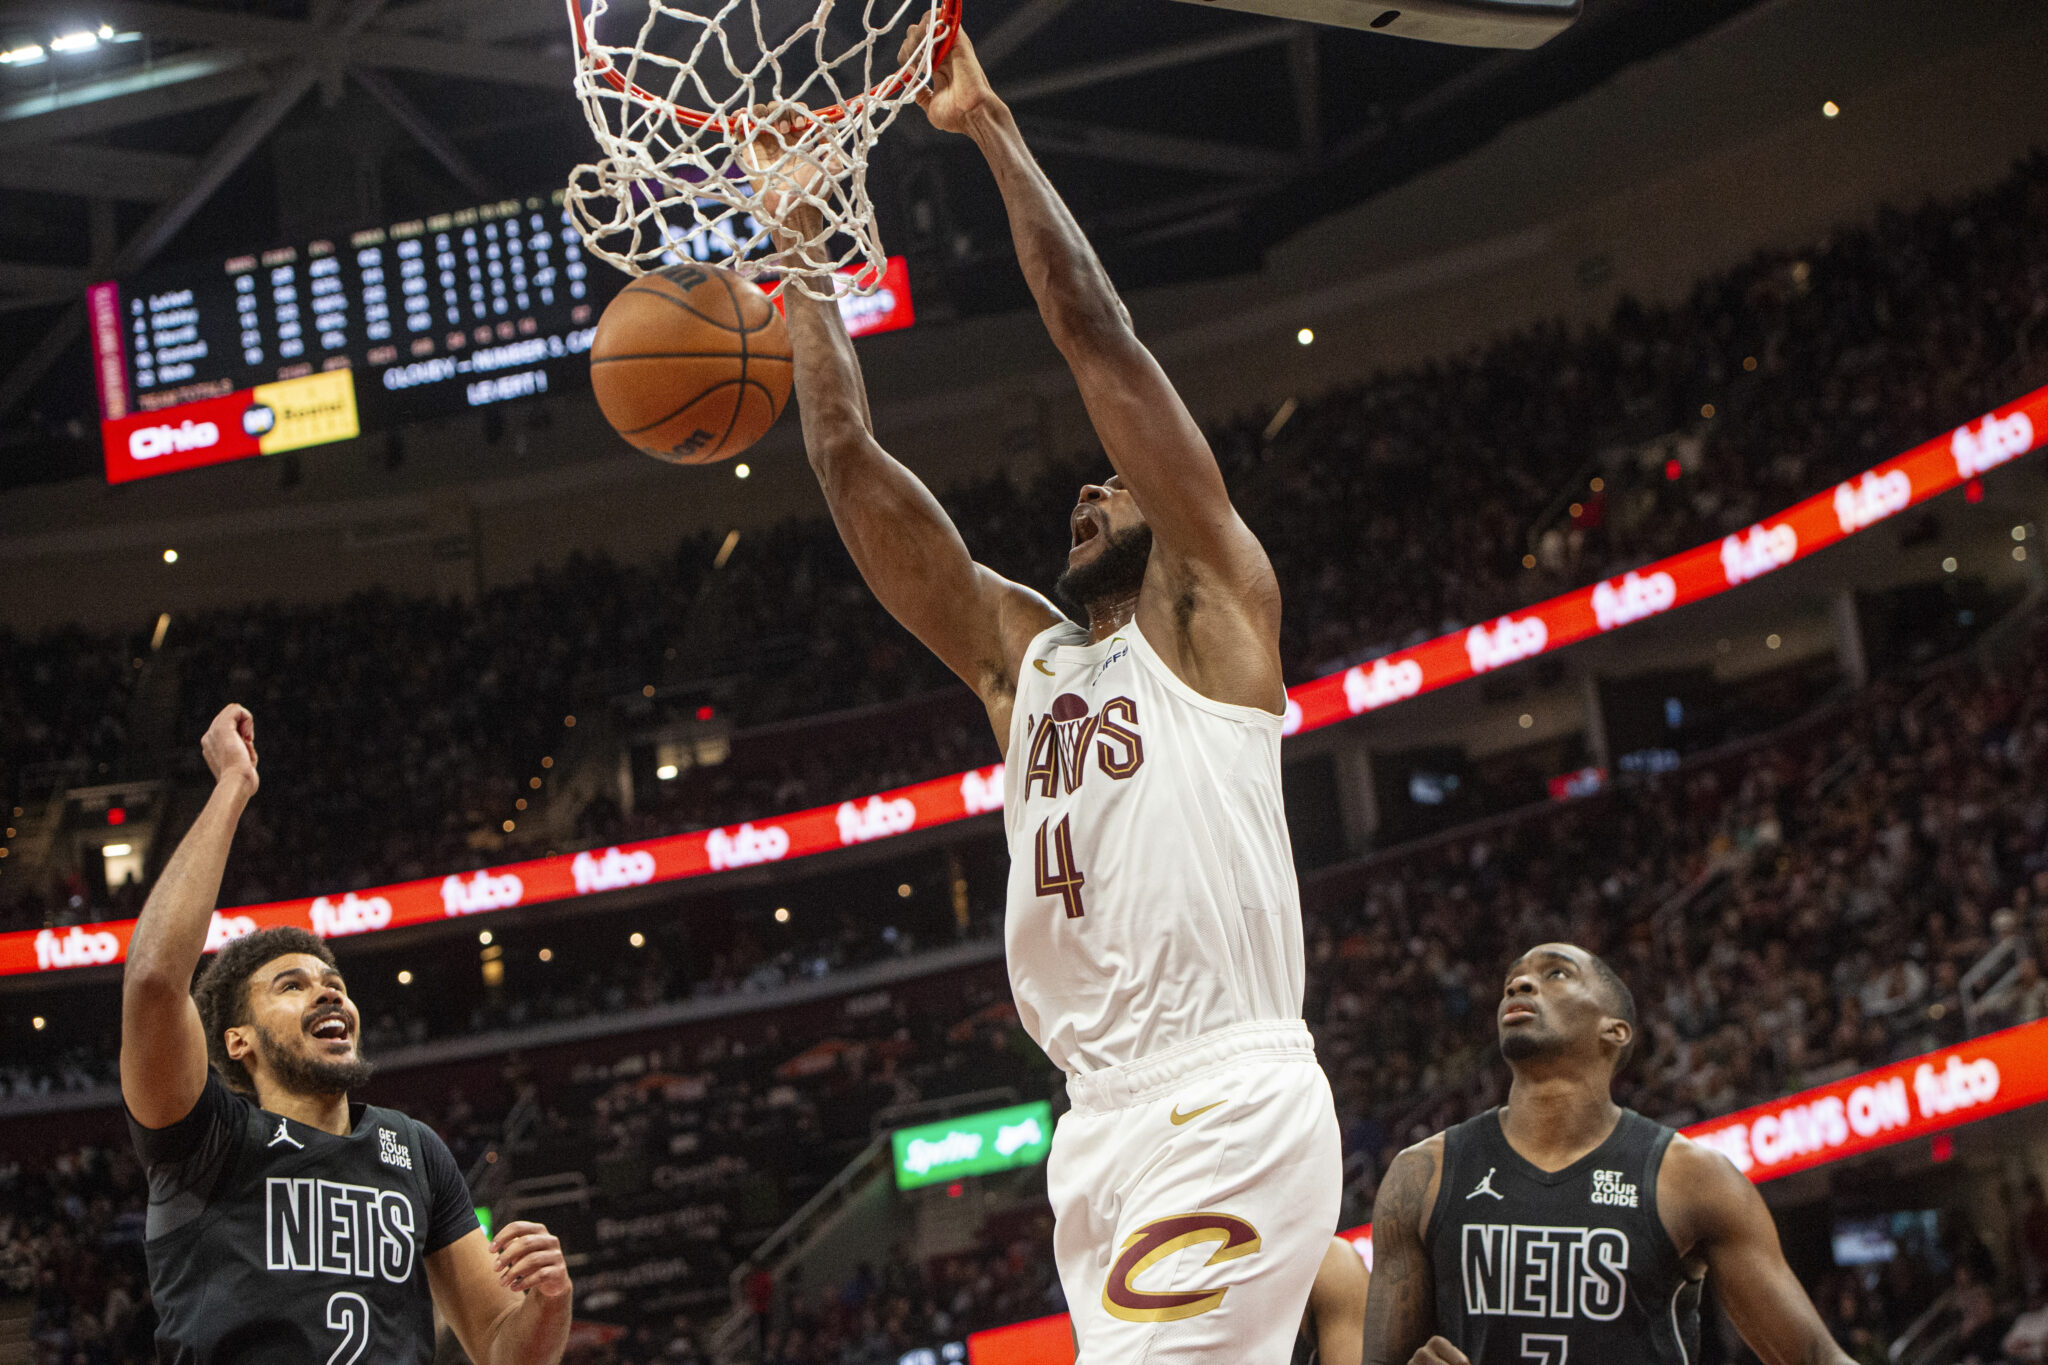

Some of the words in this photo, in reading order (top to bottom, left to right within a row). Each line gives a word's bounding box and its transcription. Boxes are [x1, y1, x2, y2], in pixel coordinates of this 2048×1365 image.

[129, 420, 219, 461] Ohio
[1025, 694, 1144, 804] AVS
[837, 795, 915, 845] fubo
[573, 847, 655, 894] fubo
[706, 823, 789, 871] fubo
[1035, 812, 1084, 918] 4
[311, 891, 392, 938] fubo
[441, 869, 523, 917] fubo
[36, 927, 118, 970] fubo
[1847, 1076, 1909, 1137] ON
[1913, 1055, 2000, 1119] fubo
[378, 1127, 398, 1144] GET
[380, 1140, 409, 1158] YOUR
[380, 1151, 413, 1171] GUIDE
[1593, 1169, 1624, 1183] GET
[1591, 1192, 1639, 1208] GUIDE
[1593, 1181, 1637, 1196] YOUR
[266, 1177, 415, 1283] NETS
[1461, 1224, 1629, 1321] NETS
[326, 1291, 369, 1365] 2
